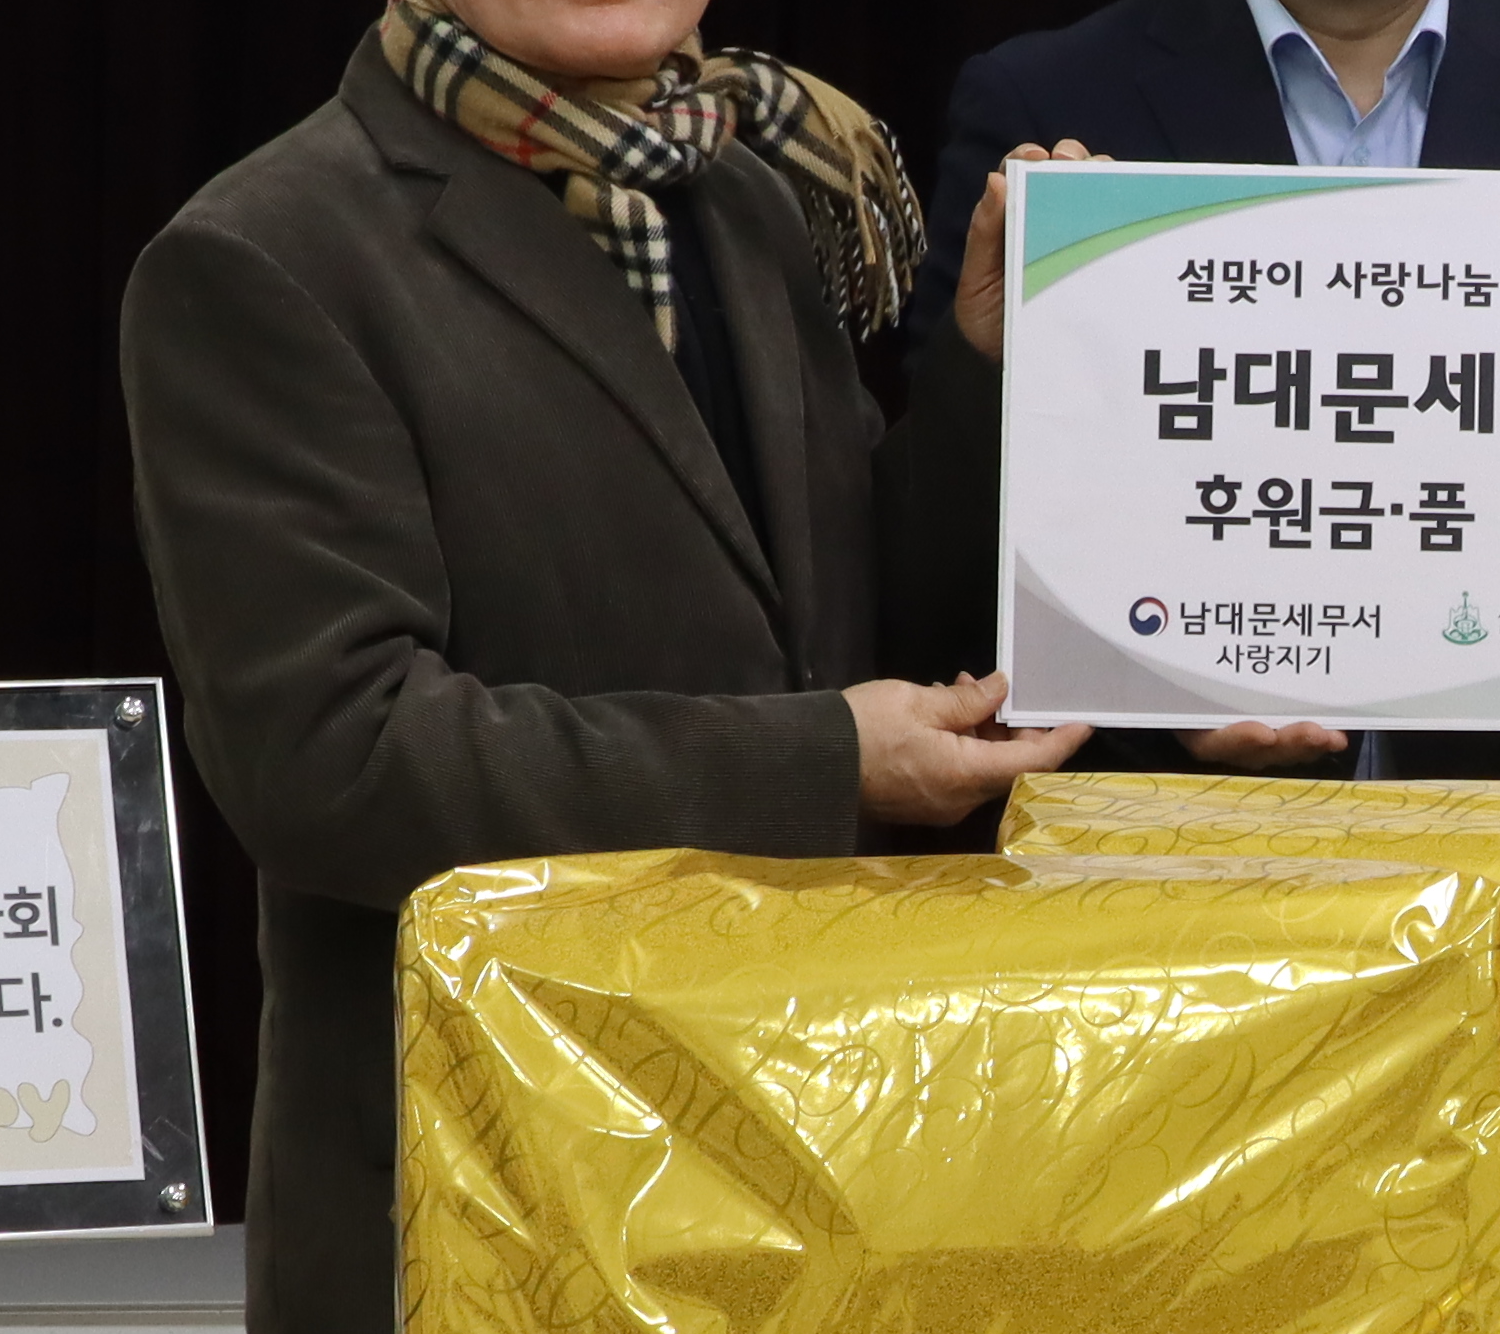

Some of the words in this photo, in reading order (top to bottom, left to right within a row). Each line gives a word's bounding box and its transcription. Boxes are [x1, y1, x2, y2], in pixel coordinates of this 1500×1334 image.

[1176, 258, 1303, 305] 설맞이
[1325, 260, 1500, 308] 사랑나눔
[1179, 601, 1382, 639] 남대문세무서
[1214, 643, 1332, 675] 사랑지기
